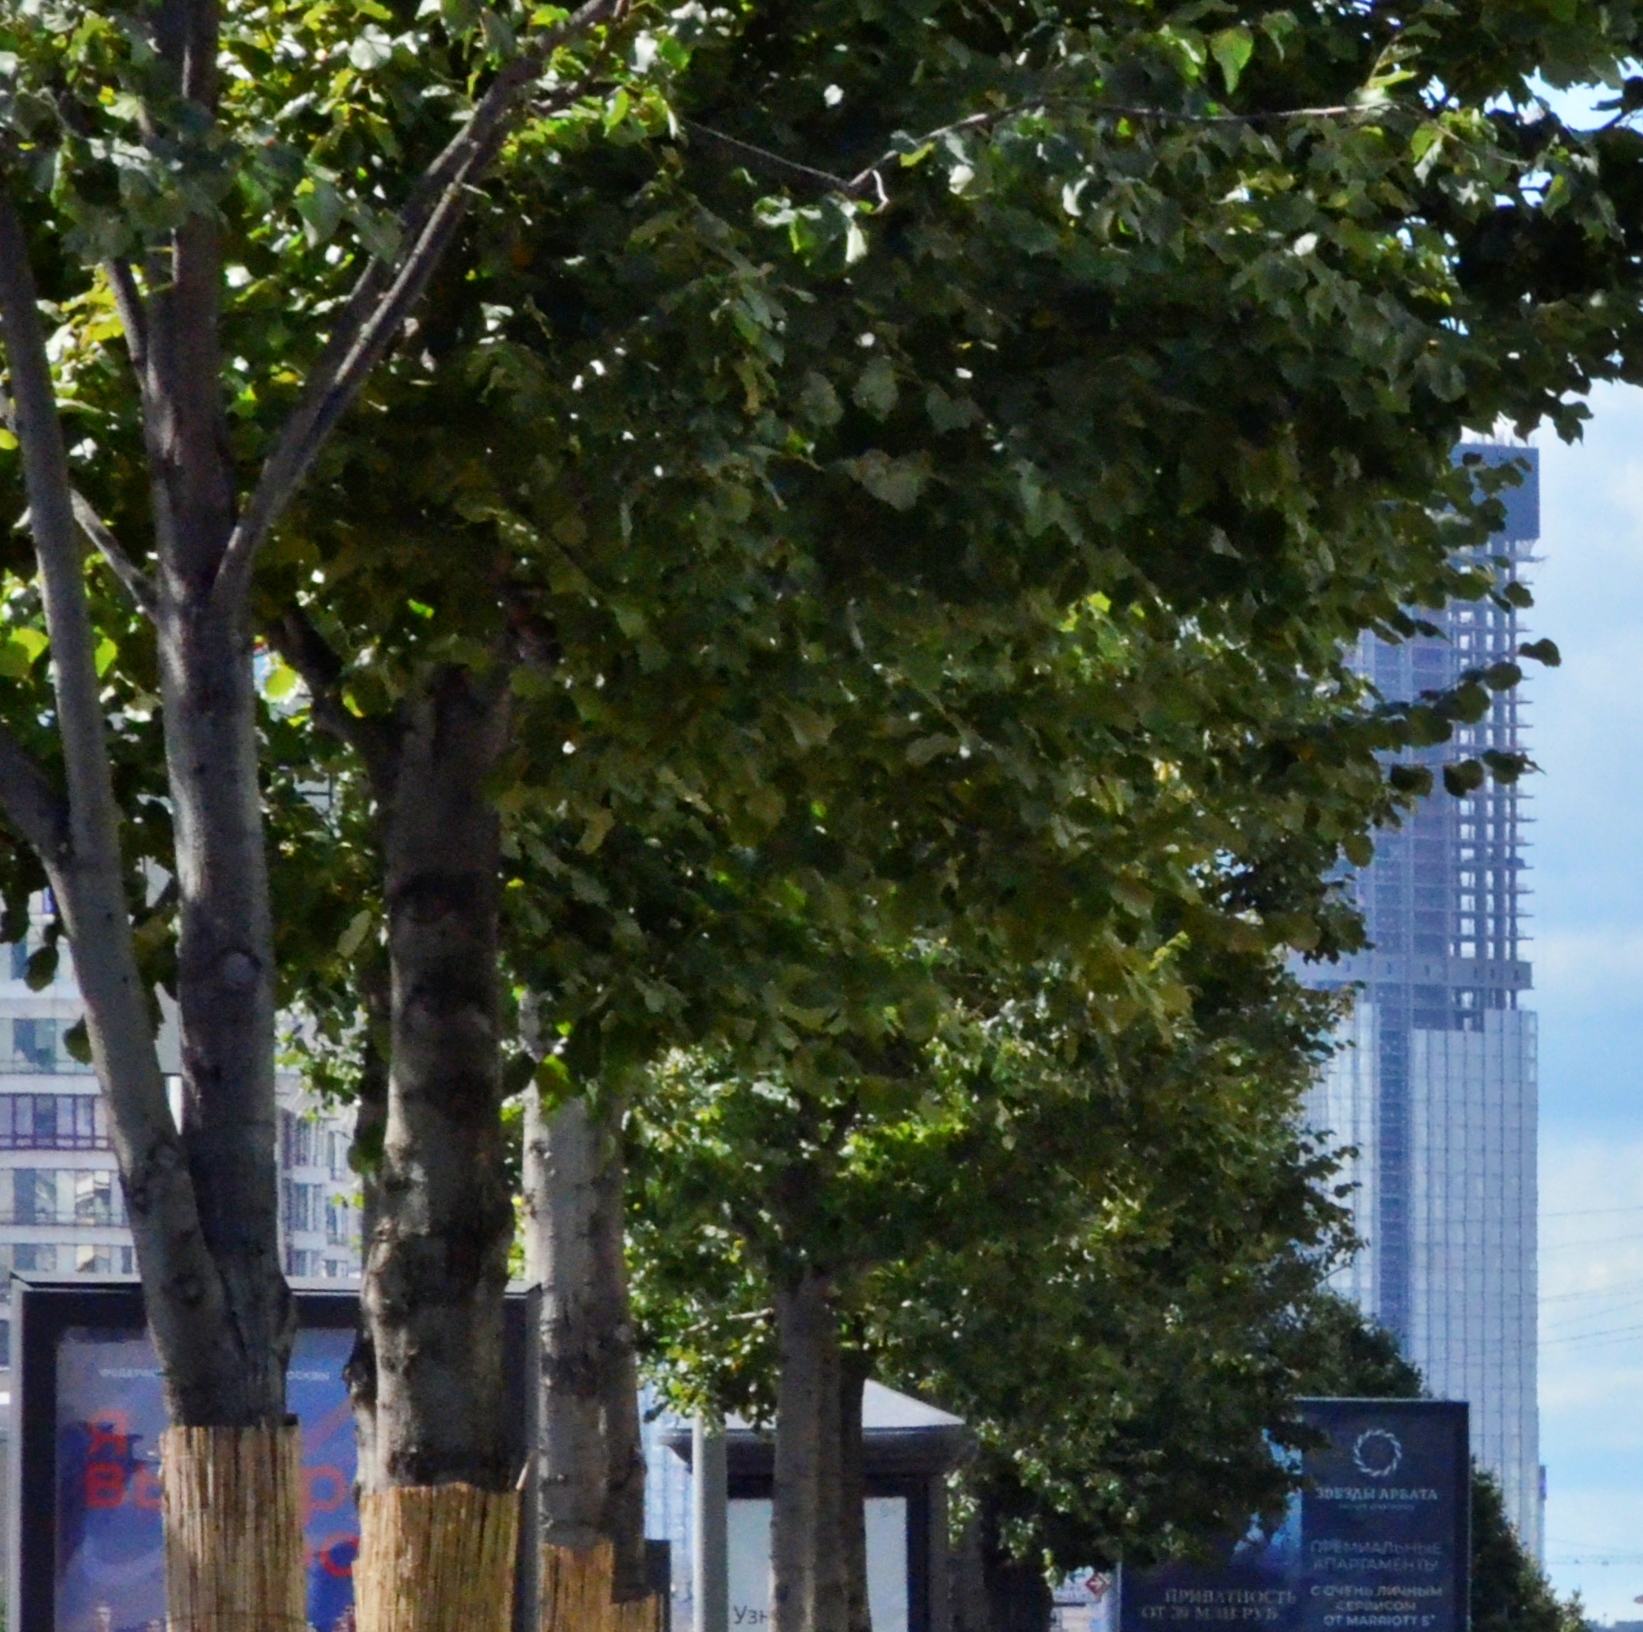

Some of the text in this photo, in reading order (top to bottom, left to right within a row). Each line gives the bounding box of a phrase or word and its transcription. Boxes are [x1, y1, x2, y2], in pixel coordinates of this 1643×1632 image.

[1316, 1488, 1438, 1501] ЗВЕЗДЫ АРБАТА
[1346, 1615, 1417, 1626] MARRIOTT
